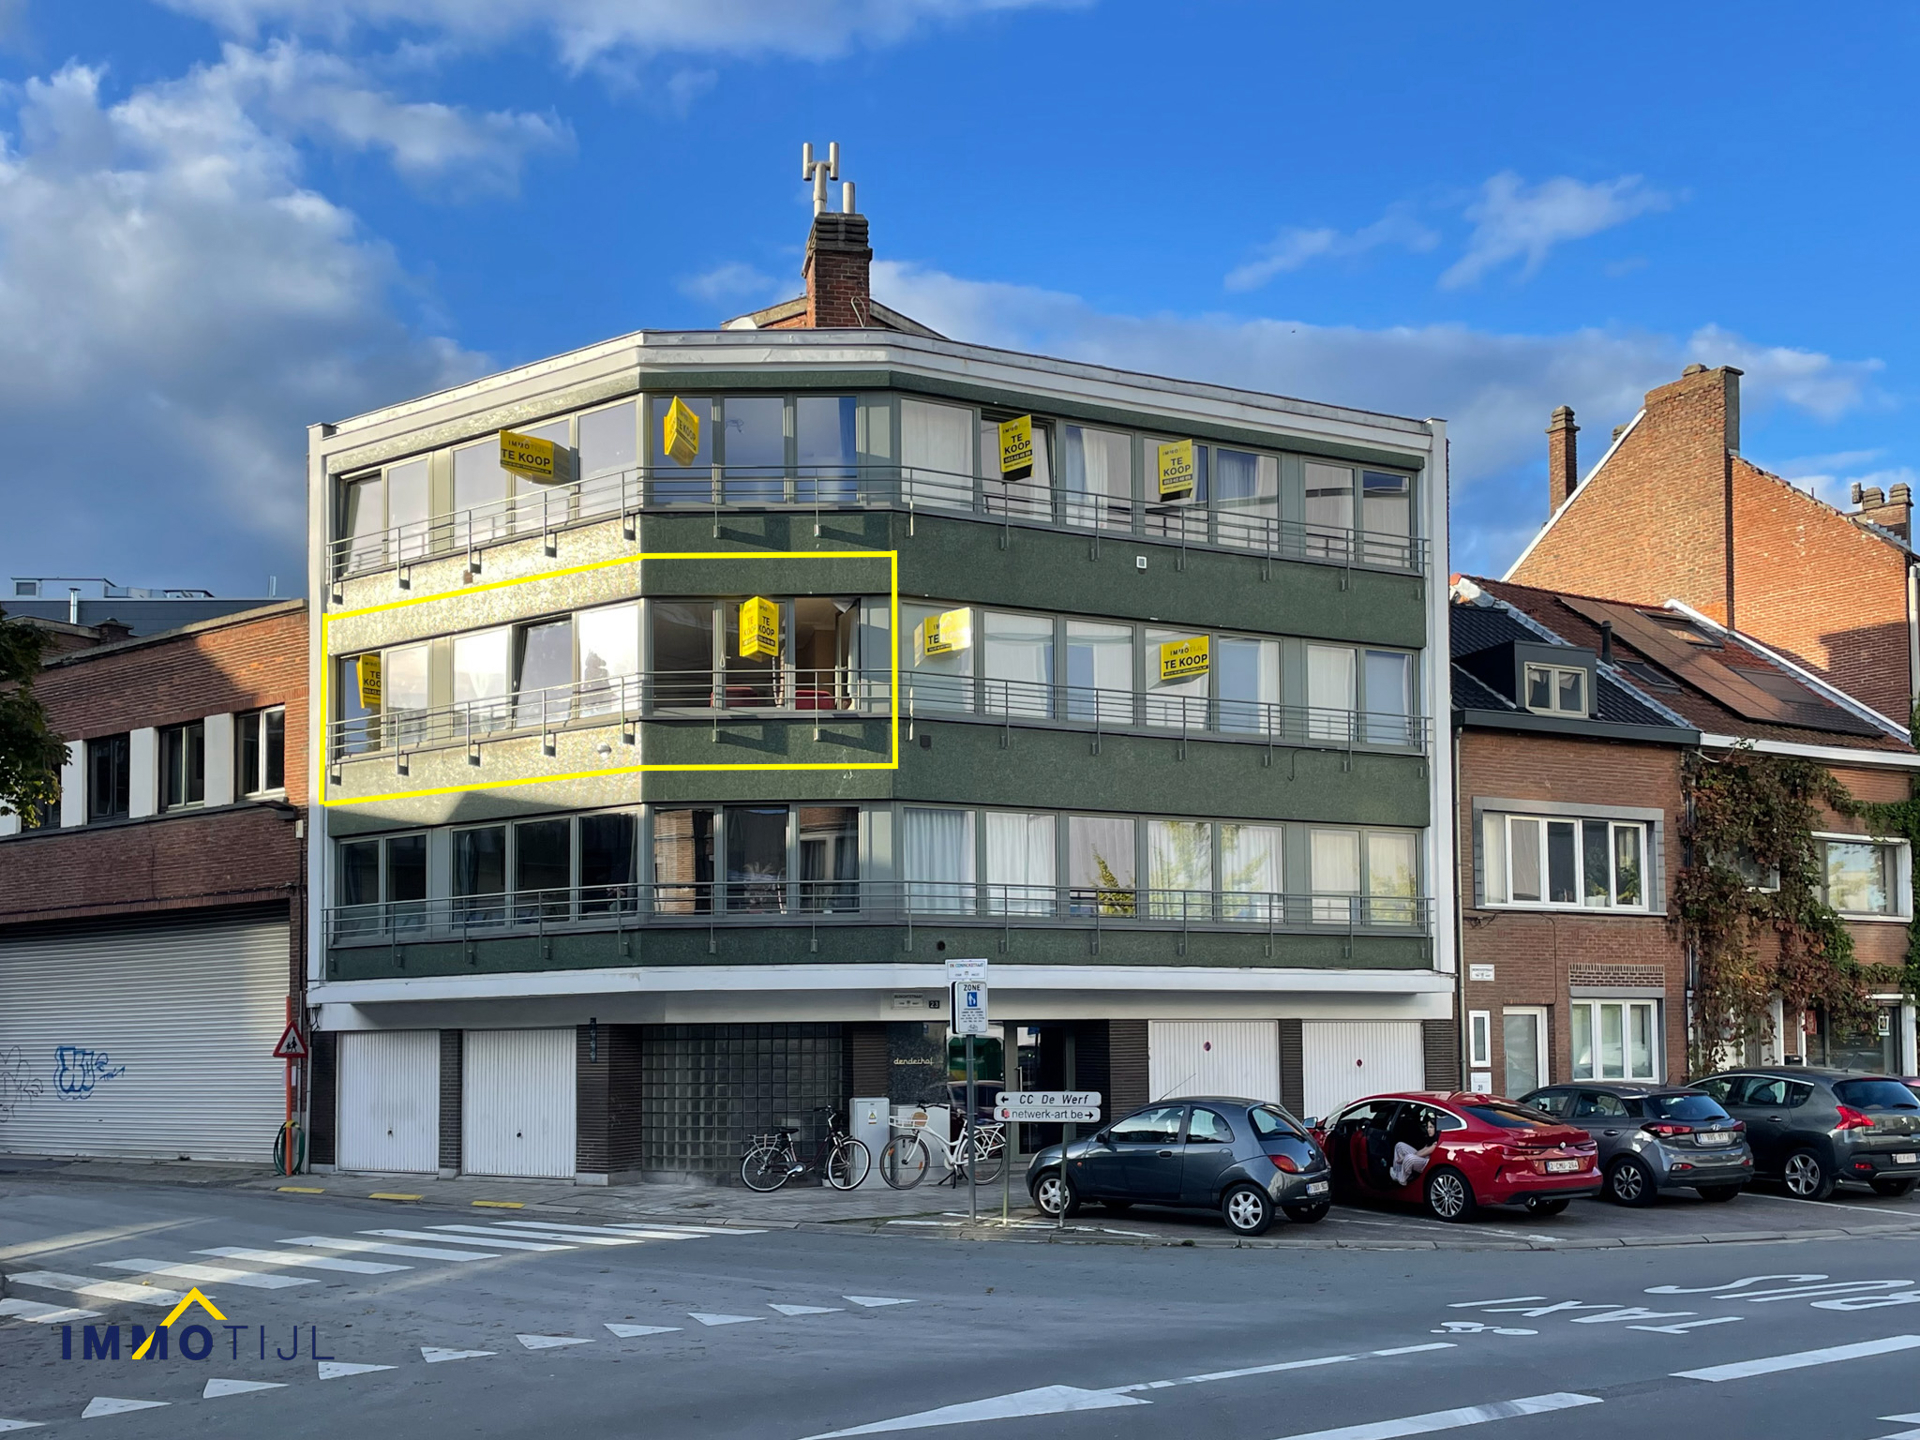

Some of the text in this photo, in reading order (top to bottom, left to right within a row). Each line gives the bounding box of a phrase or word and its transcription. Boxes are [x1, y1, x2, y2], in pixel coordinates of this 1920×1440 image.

[1011, 433, 1023, 443] TE
[1004, 440, 1031, 455] KOOP
[501, 448, 550, 467] TE KOOP
[1170, 457, 1183, 466] TE
[1163, 464, 1191, 477] KOOP
[762, 615, 770, 626] TE
[758, 624, 775, 636] KOOP
[928, 634, 940, 645] TE
[1164, 653, 1208, 670] TE KOOP
[369, 670, 381, 679] TE
[363, 678, 381, 688] KOO
[930, 1000, 939, 1008] 23
[1020, 1094, 1089, 1105] CC De Werf
[1012, 1109, 1083, 1119] netwerk-art.be
[1447, 1296, 1745, 1335] TAXI
